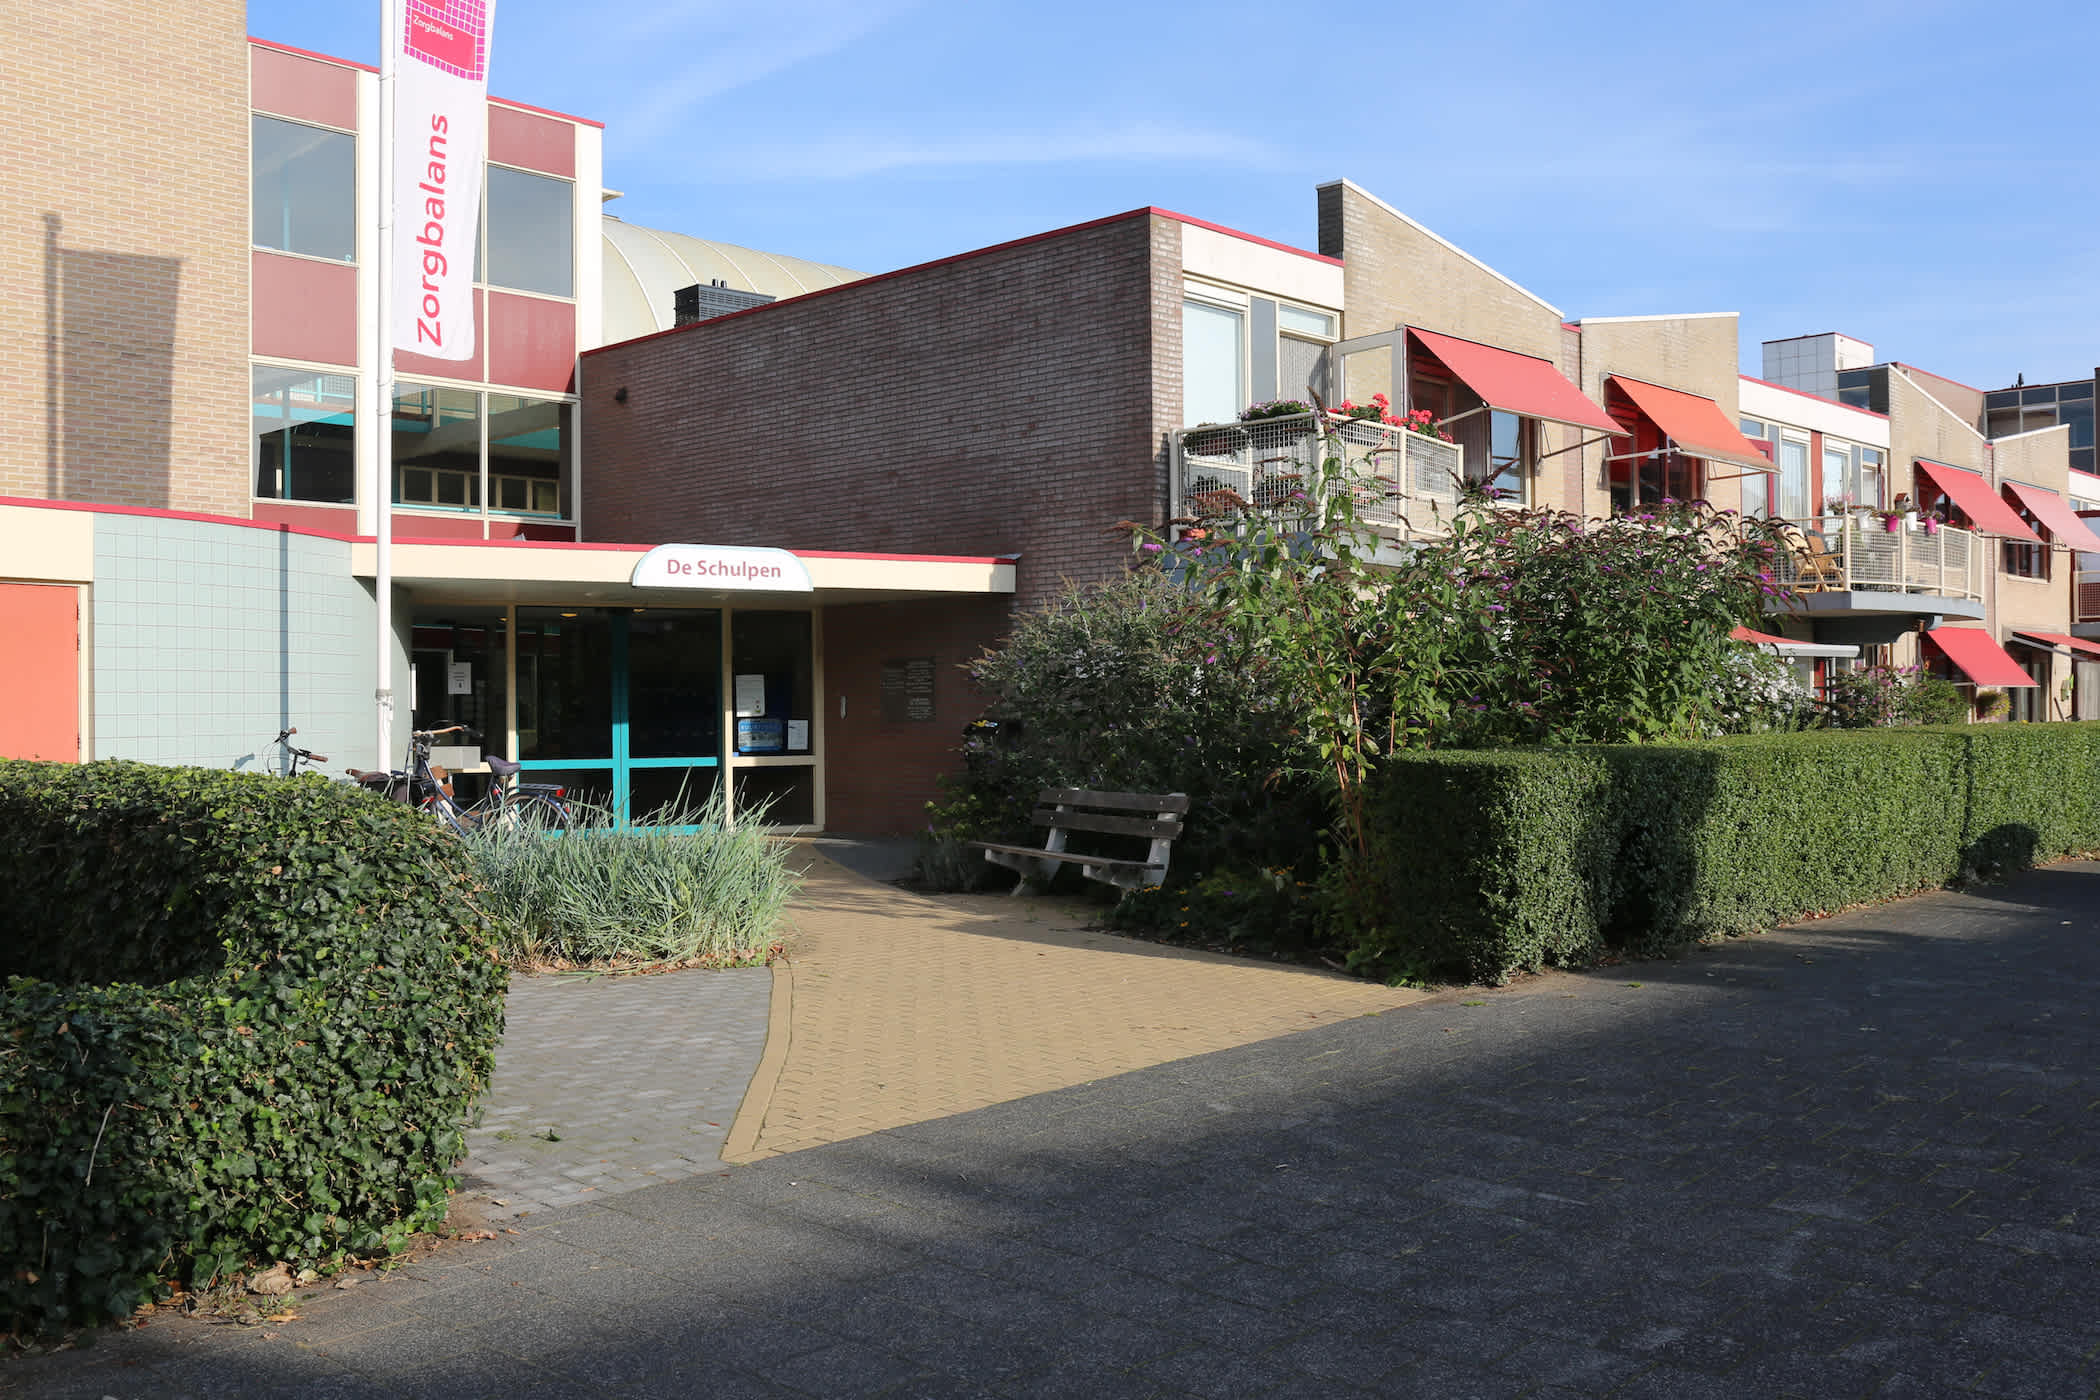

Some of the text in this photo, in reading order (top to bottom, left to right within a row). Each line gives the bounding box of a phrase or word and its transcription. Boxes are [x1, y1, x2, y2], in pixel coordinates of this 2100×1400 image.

[414, 14, 454, 40] Zorgbalans
[416, 113, 448, 348] Zorgbalans
[667, 559, 782, 581] De Schulpen
